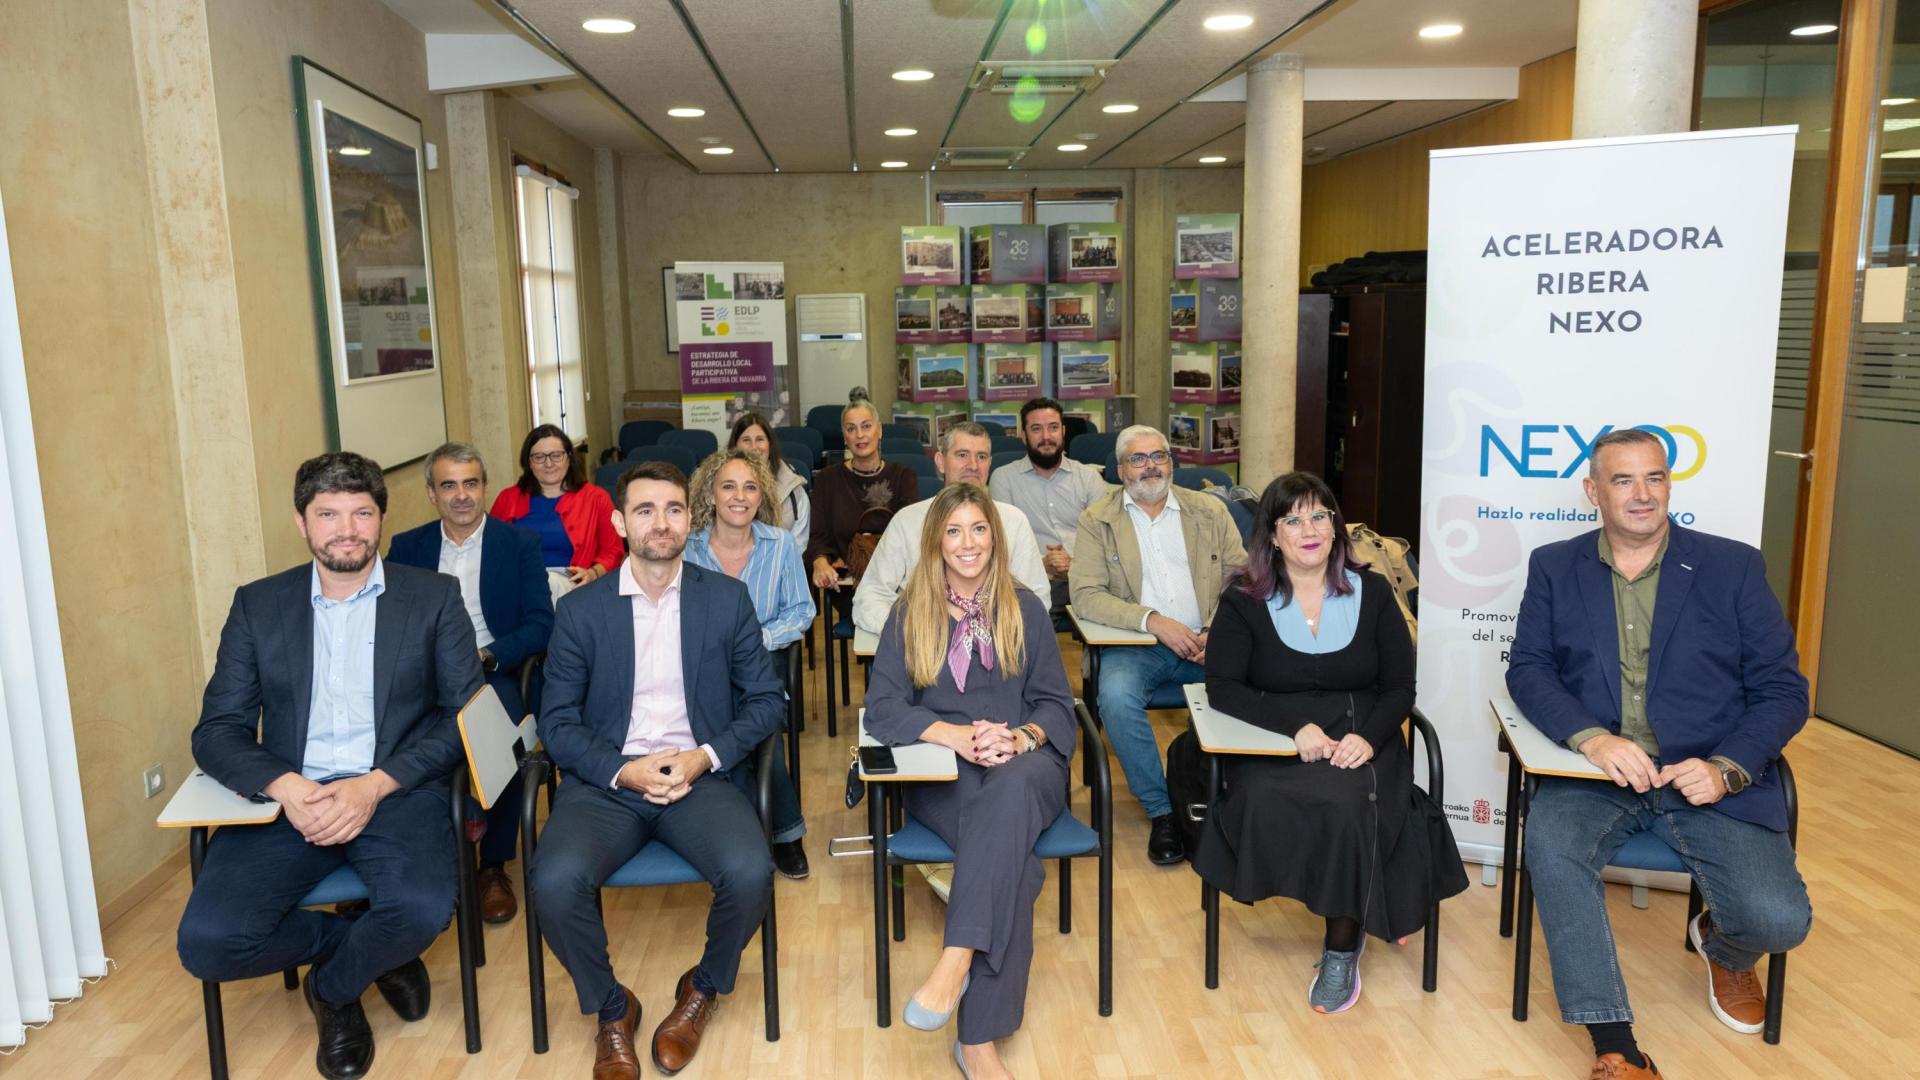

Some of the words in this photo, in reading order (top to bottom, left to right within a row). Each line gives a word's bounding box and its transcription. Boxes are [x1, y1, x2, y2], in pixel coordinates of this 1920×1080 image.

[1009, 239, 1029, 256] 30
[1481, 225, 1724, 258] ACELERADORA
[1537, 269, 1650, 295] RIBERA
[1217, 295, 1238, 312] 30
[734, 305, 760, 316] EDLP
[1549, 310, 1642, 334] NEXO
[690, 351, 729, 360] ESTRATEGIA
[691, 360, 731, 368] DESARROLLO
[732, 359, 752, 367] LOCAL
[691, 368, 738, 377] PARTICIPATIVA
[692, 377, 700, 385] DE
[701, 377, 709, 385] LA
[710, 376, 731, 384] RIBERA
[739, 375, 767, 383] NAVARRA
[1477, 505, 1523, 520] Hazlo
[1529, 506, 1598, 522] realidad
[1668, 511, 1696, 526] XO
[1461, 608, 1517, 622] Promov
[1472, 628, 1494, 642] del
[1499, 634, 1514, 643] se
[1500, 650, 1511, 663] R
[1444, 813, 1470, 821] ernua
[1493, 808, 1507, 817] Go
[1493, 817, 1505, 826] de
